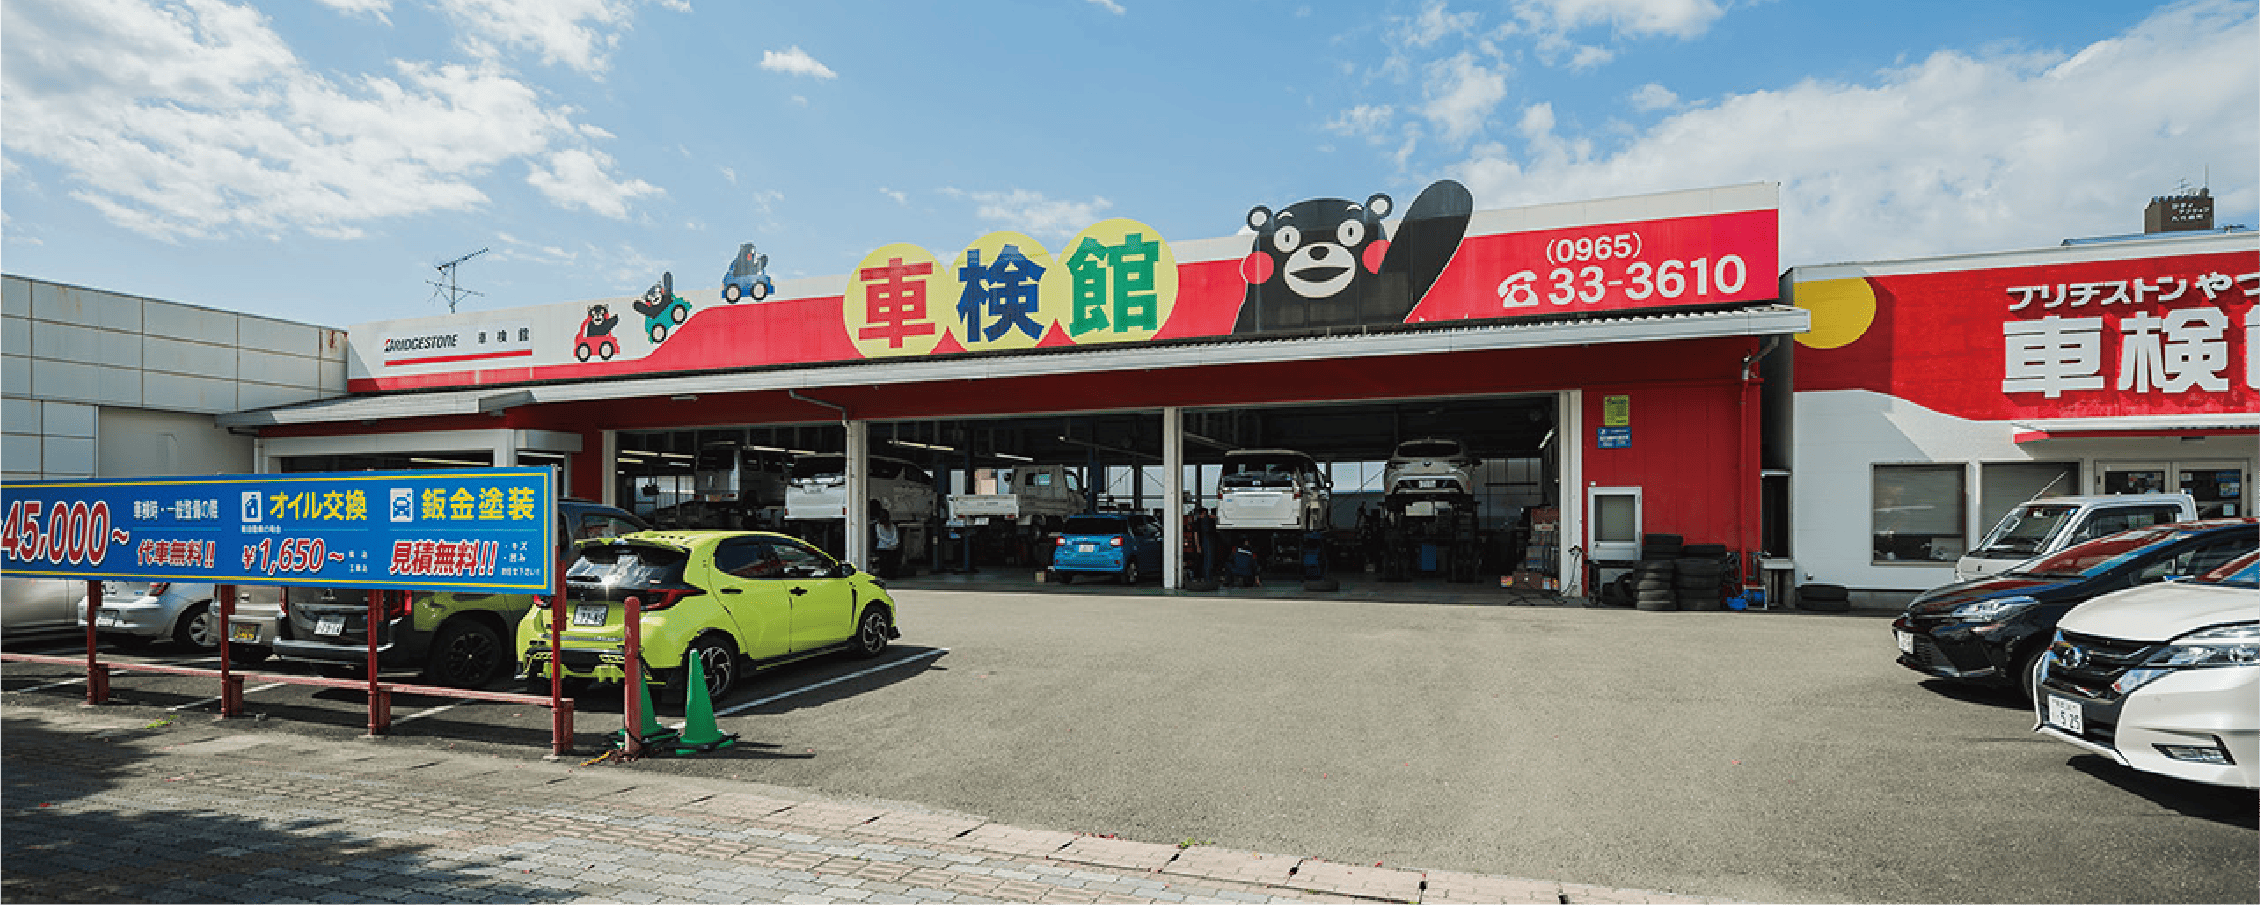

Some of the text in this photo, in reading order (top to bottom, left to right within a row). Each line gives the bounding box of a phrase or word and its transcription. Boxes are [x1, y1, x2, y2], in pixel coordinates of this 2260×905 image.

[1547, 231, 1642, 264] (0965)
[858, 233, 1160, 348] 車検館
[1549, 254, 1747, 305] 33-3610
[384, 334, 458, 353] BRIDGESTONE
[2002, 307, 2259, 398] 車検
[269, 490, 367, 521] オイル交換
[421, 487, 535, 520] 鈑金塗装
[0, 500, 129, 565] 45,000~
[388, 539, 499, 576] 見積無料!!
